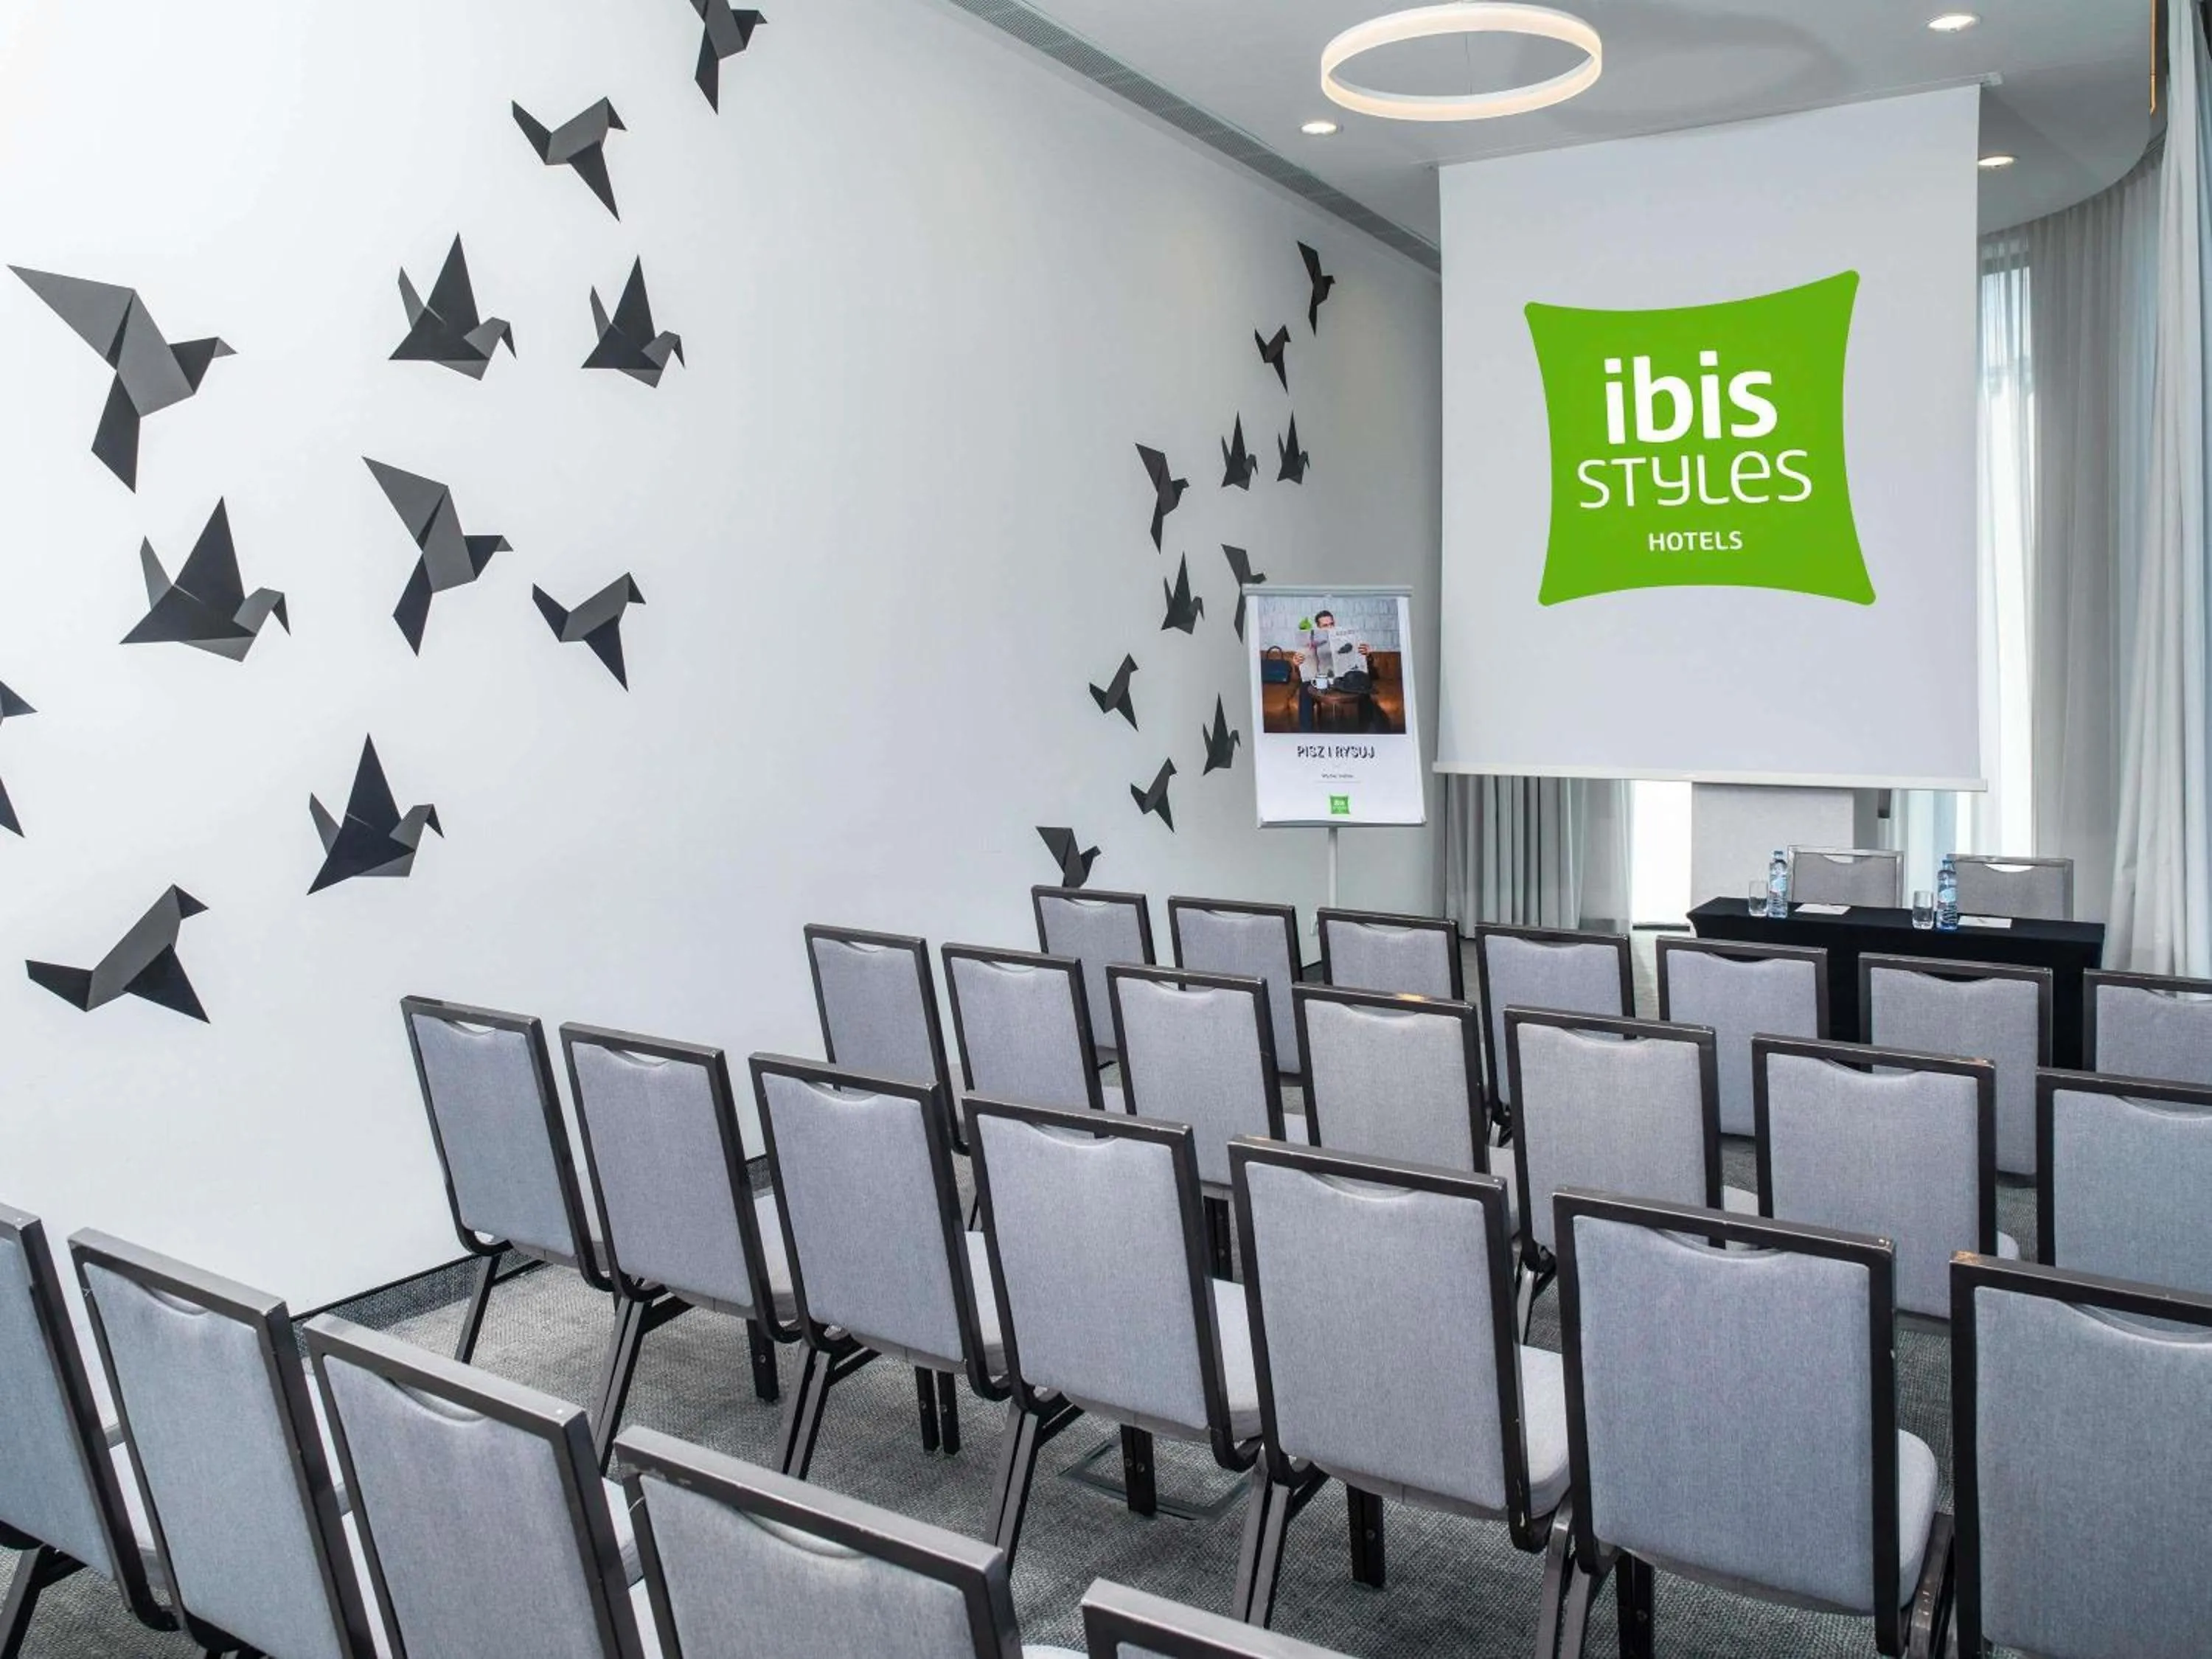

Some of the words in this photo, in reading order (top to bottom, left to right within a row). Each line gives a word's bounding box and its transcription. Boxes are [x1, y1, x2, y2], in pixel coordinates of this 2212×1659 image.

[1604, 349, 1778, 445] ibis
[1648, 530, 1743, 552] HOTELS
[1297, 745, 1325, 758] PISZ
[1335, 745, 1375, 759] RYSUJ
